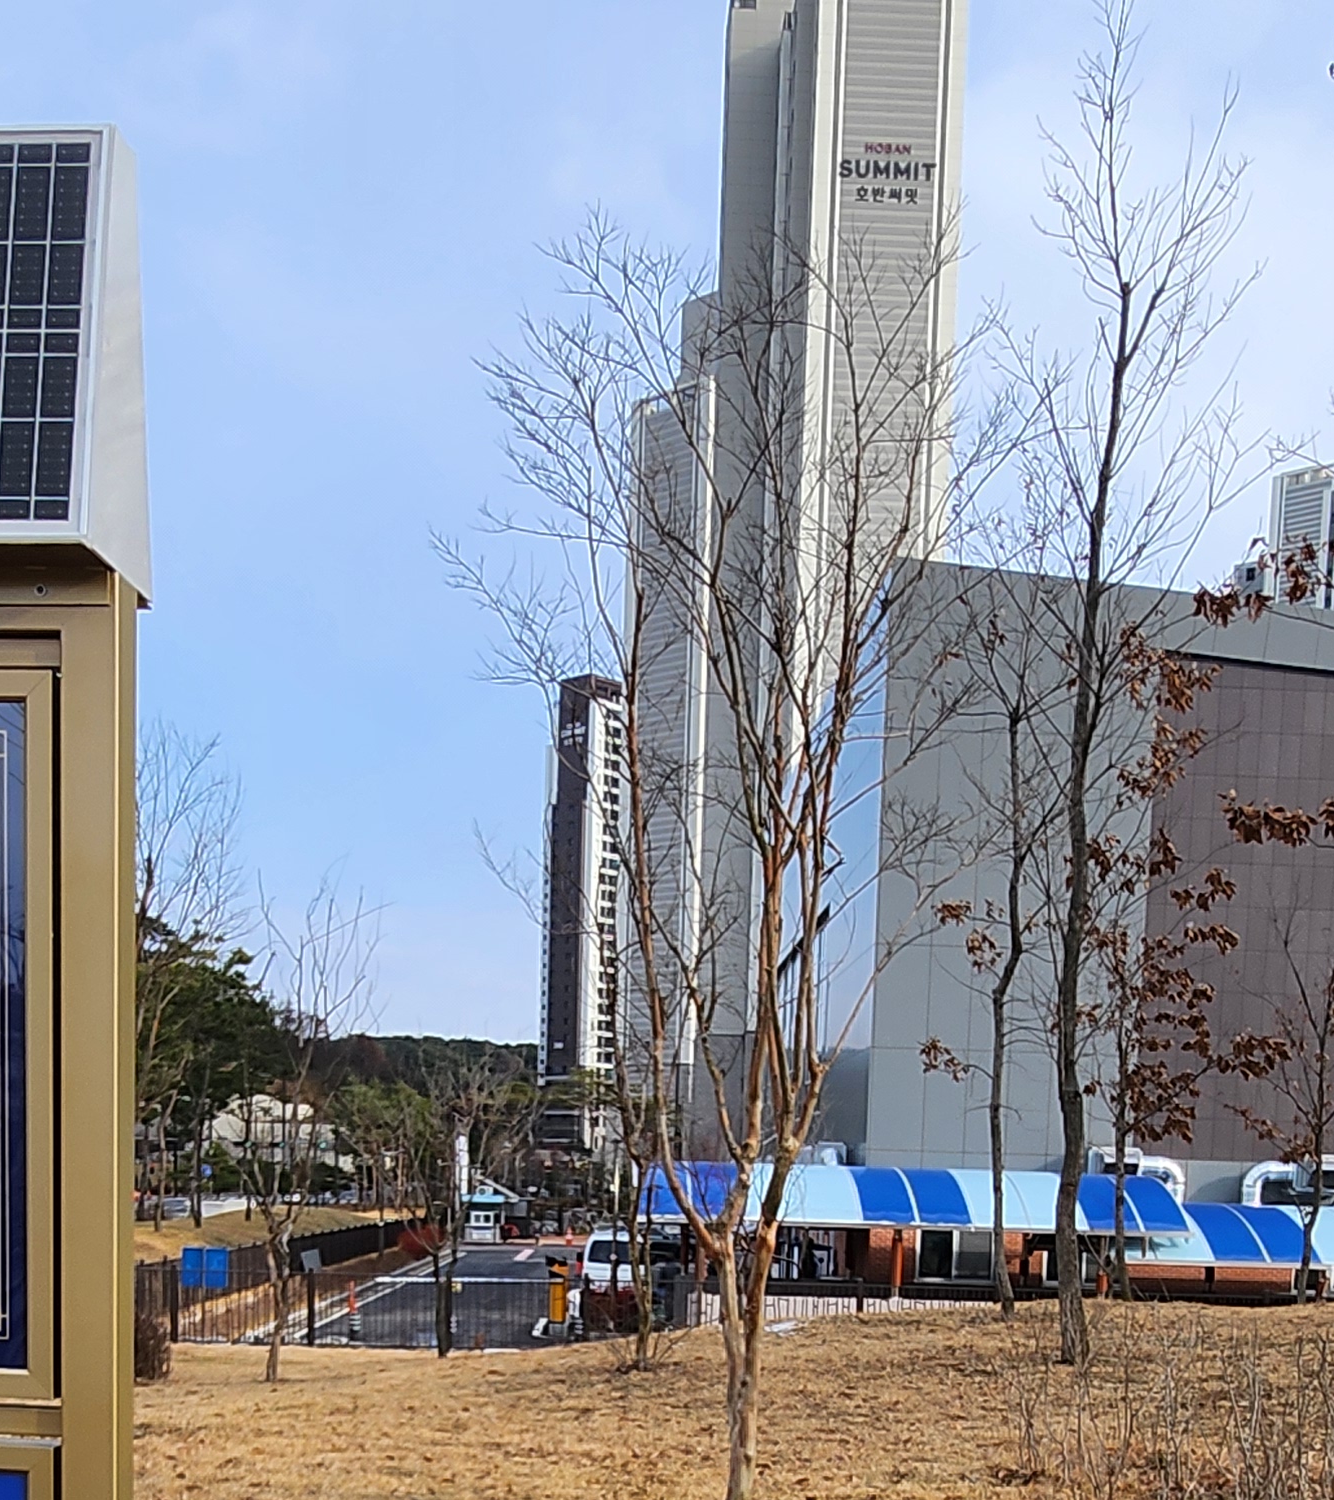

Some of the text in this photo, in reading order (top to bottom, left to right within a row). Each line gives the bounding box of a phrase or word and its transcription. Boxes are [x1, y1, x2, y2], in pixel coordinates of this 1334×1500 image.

[864, 142, 912, 155] HOBAN
[839, 159, 937, 181] SUMMIT
[855, 185, 918, 205] 호반써밋
